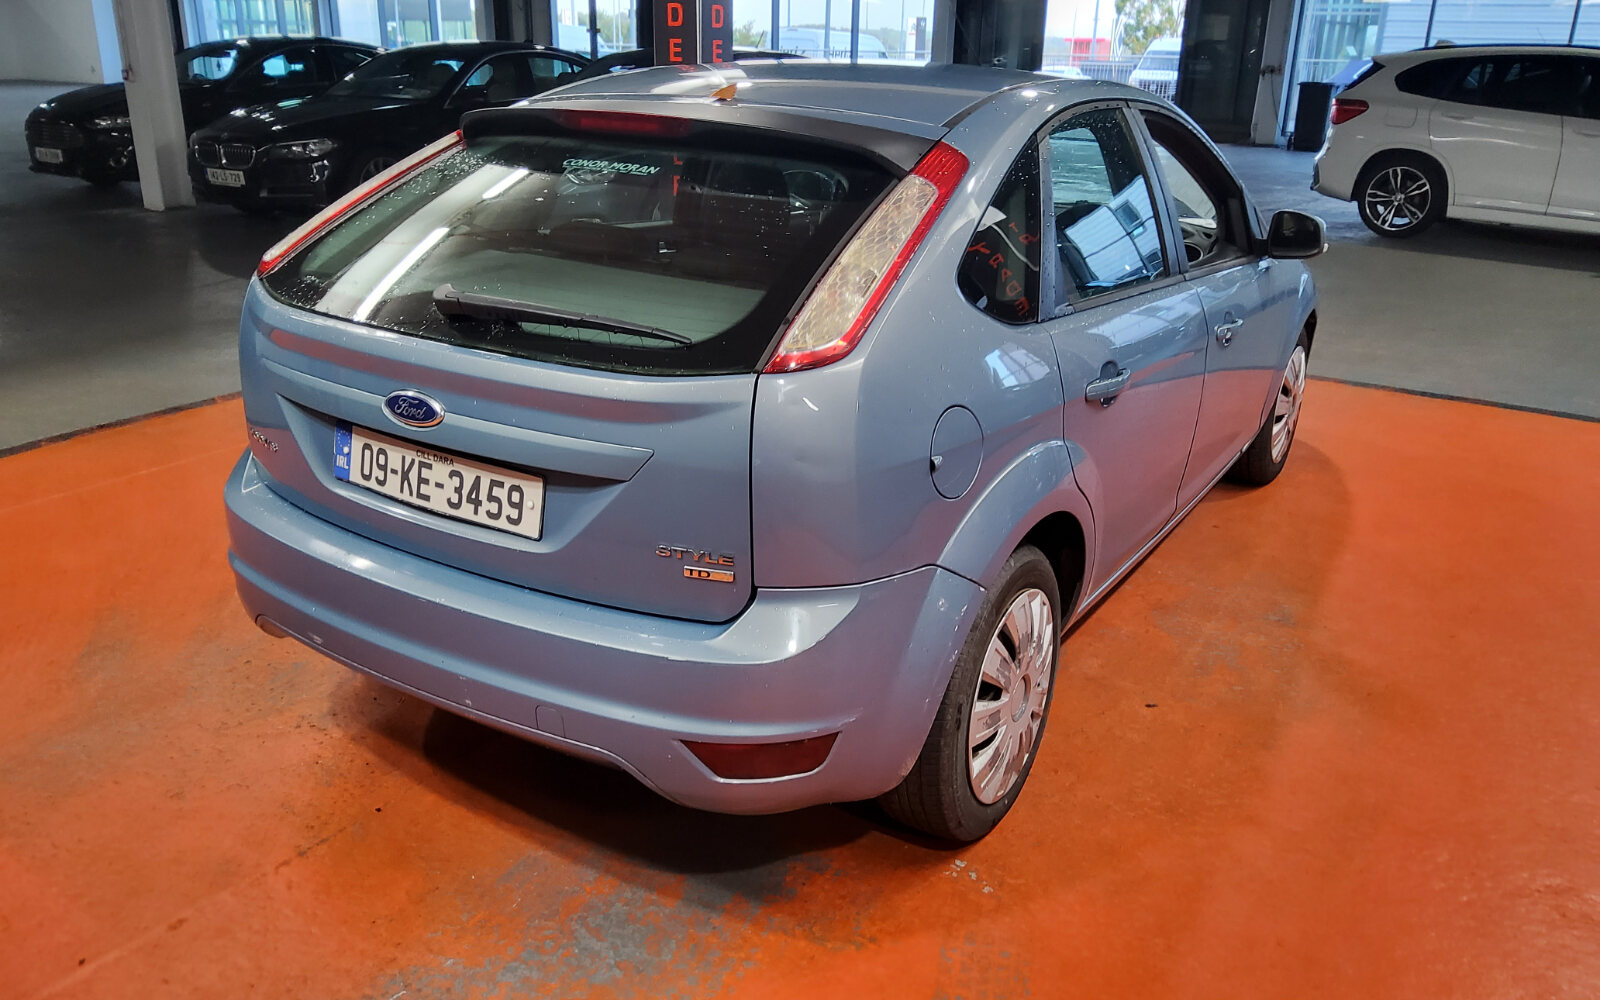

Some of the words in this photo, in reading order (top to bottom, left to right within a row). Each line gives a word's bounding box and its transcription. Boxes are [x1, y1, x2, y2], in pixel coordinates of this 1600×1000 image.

[562, 159, 608, 168] CONOR
[608, 162, 660, 174] MORAN
[394, 397, 425, 419] Ford
[336, 454, 349, 470] IRL
[416, 450, 433, 460] CILL
[433, 453, 455, 467] DARA
[360, 442, 524, 526] 09-KE-3459
[656, 545, 734, 566] STYLE
[689, 569, 711, 578] TD
